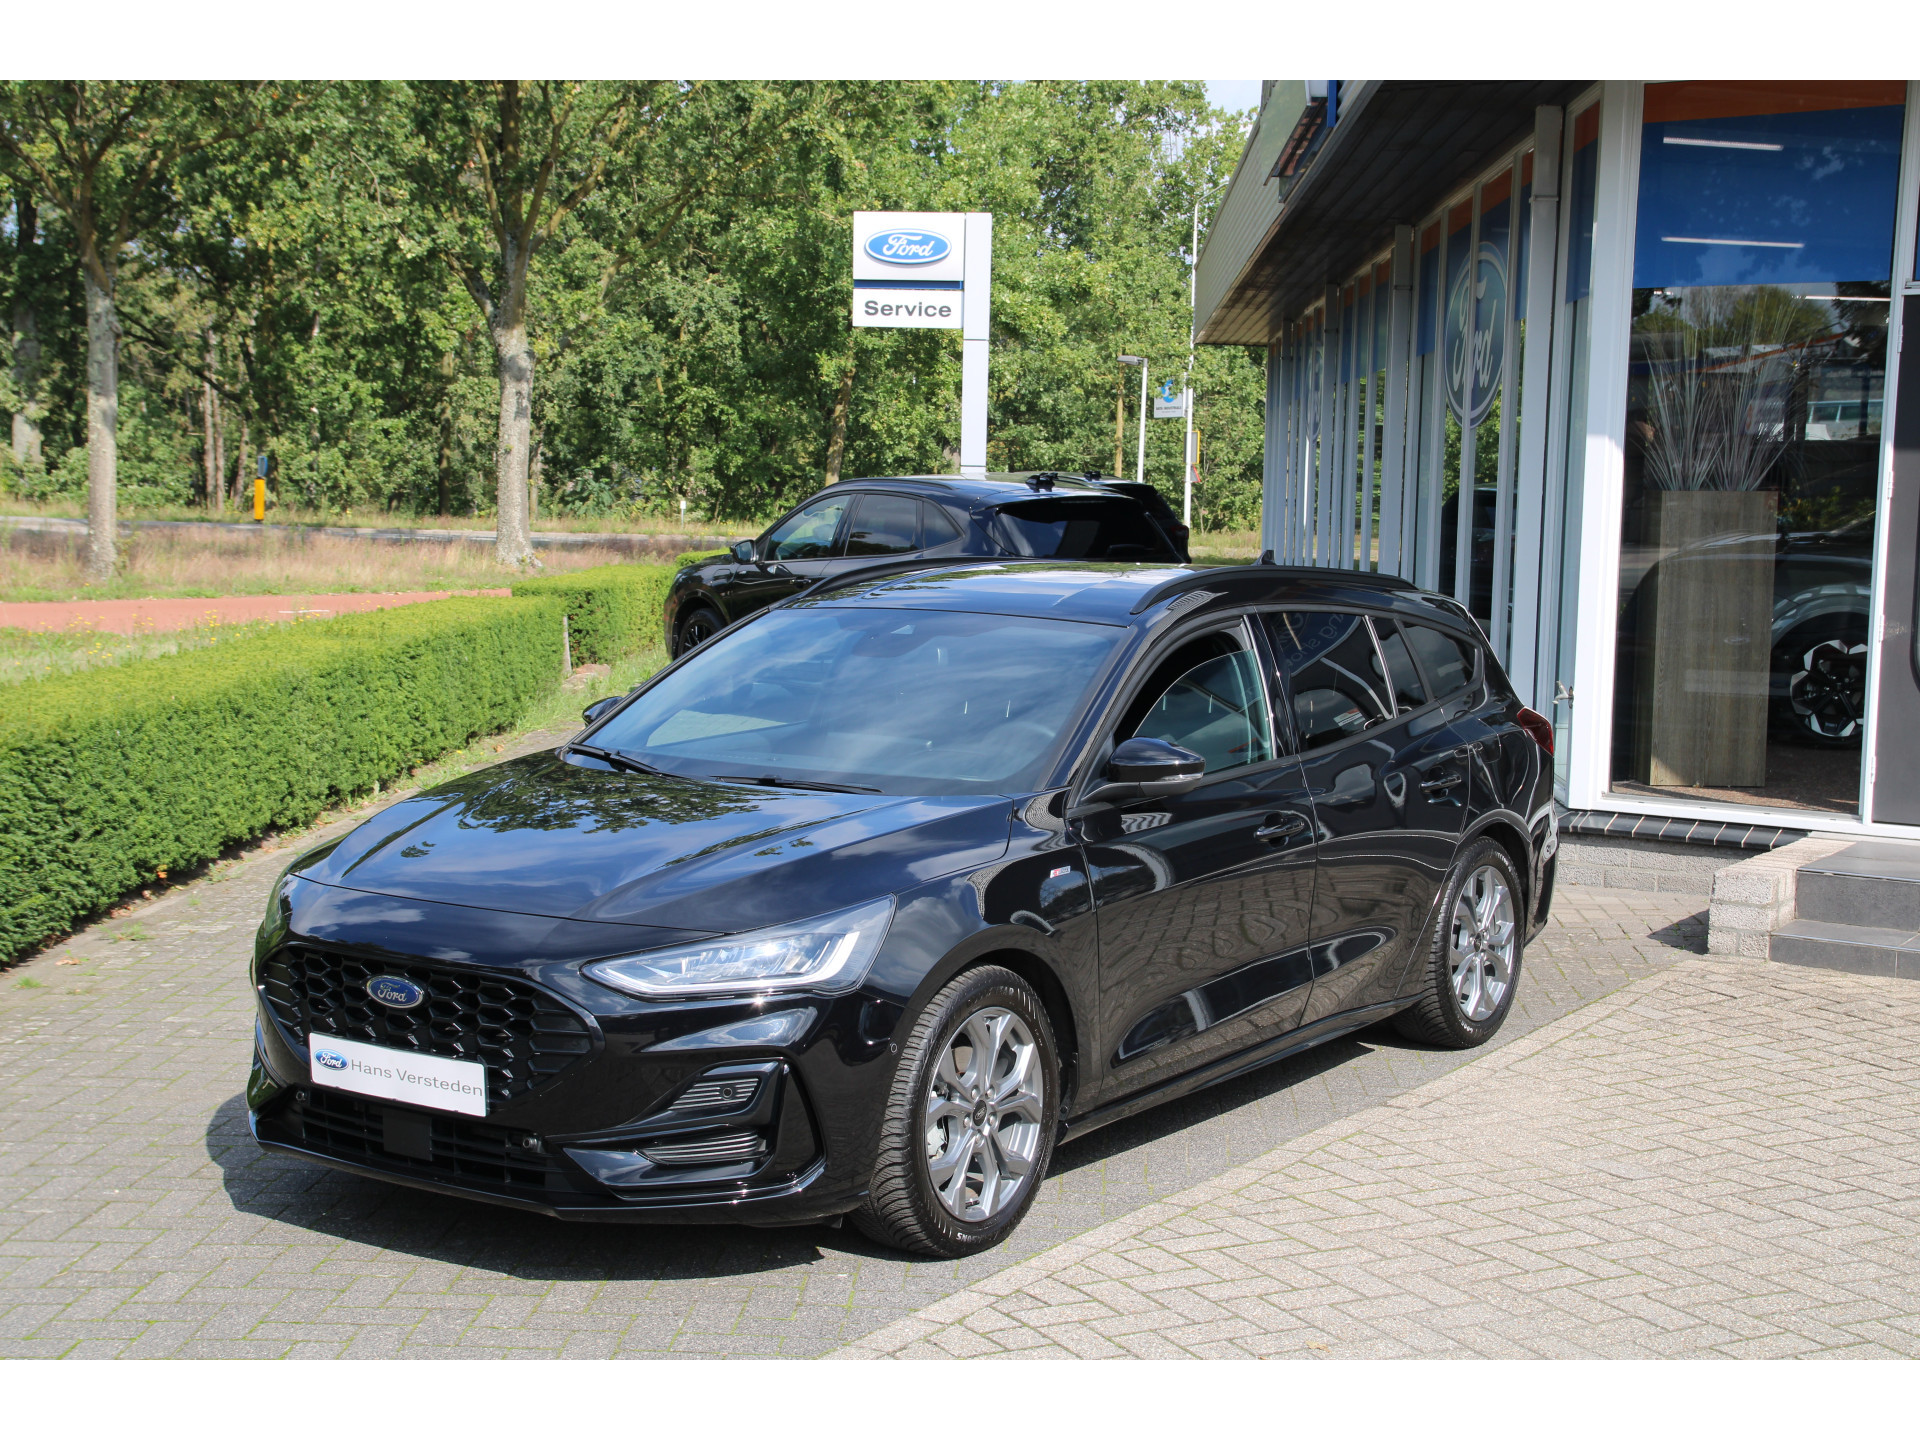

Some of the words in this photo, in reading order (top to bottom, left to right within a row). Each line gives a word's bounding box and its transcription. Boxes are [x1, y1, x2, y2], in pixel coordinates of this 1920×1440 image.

[882, 233, 935, 256] Ford
[864, 300, 952, 318] Service
[1453, 276, 1497, 392] Frd
[377, 982, 409, 1002] Ford
[318, 1052, 343, 1069] Ford
[351, 1059, 392, 1079] Hans
[396, 1068, 483, 1097] Versteden
